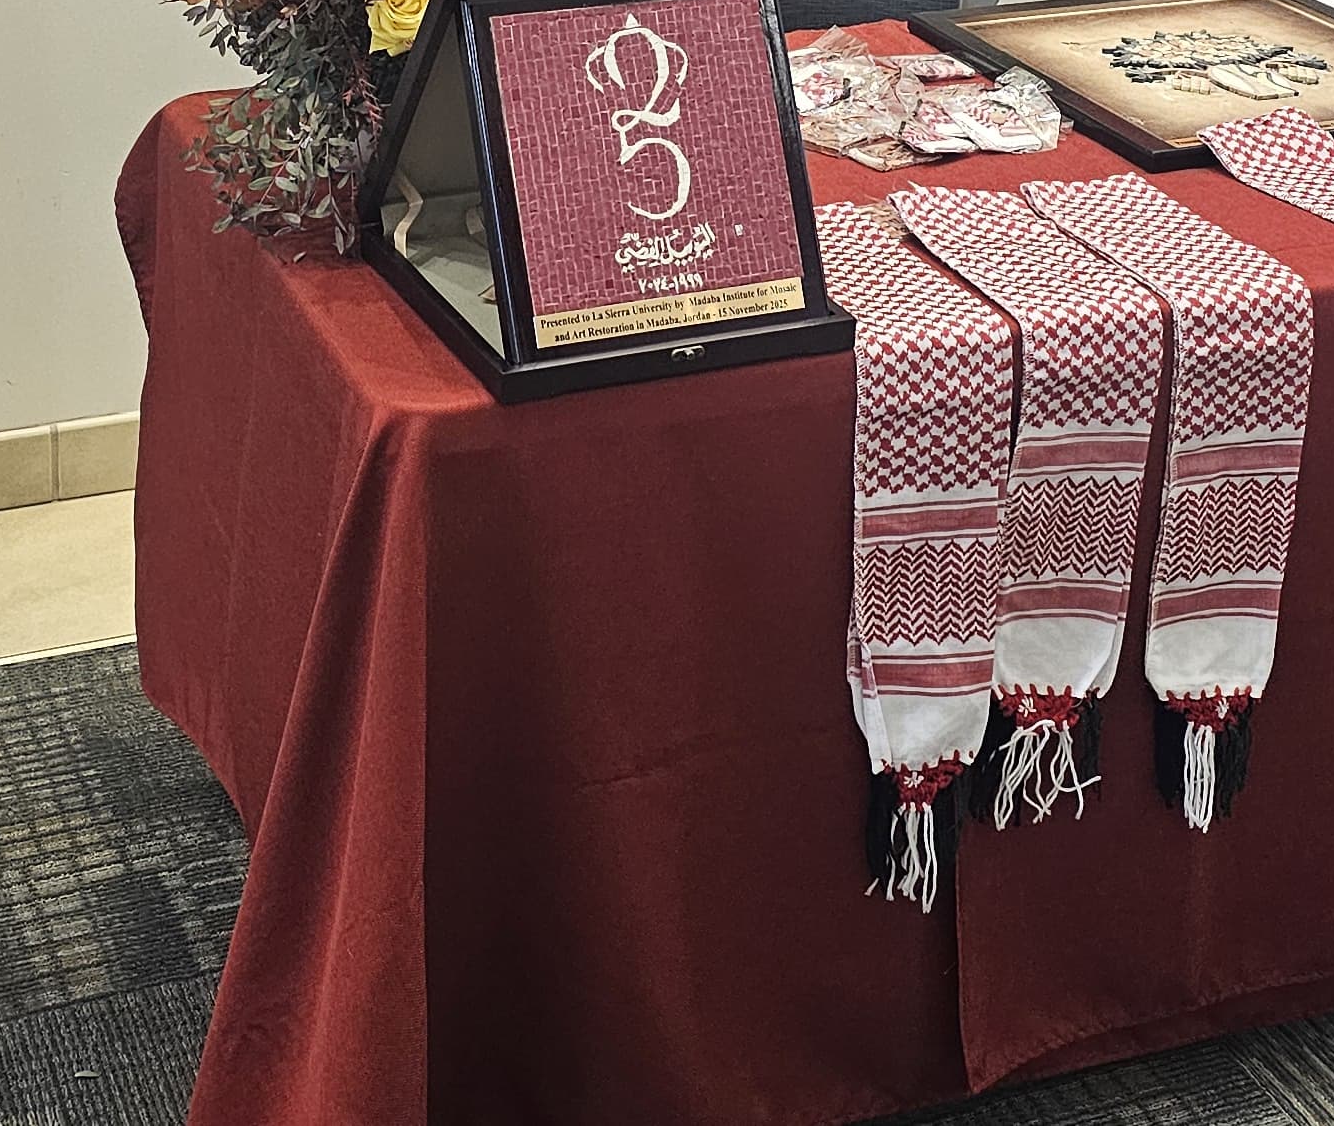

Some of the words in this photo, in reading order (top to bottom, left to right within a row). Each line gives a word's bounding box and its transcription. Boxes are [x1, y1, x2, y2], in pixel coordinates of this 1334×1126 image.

[540, 316, 581, 329] Presented
[582, 314, 591, 322] to
[592, 312, 604, 321] La
[605, 308, 631, 320] Sierra
[632, 301, 673, 316] University
[674, 300, 685, 311] by
[689, 295, 721, 307] Madaba
[722, 290, 755, 302] Institute
[757, 286, 768, 296] for
[770, 283, 797, 295] Mosaic
[555, 332, 571, 342] and
[572, 329, 587, 340] Art
[587, 322, 635, 338] Restoration
[636, 320, 645, 330] in
[646, 315, 682, 329] Madaba,
[683, 311, 711, 323] Jordan
[718, 307, 727, 318] 15
[729, 302, 768, 317] November
[770, 298, 788, 311] 2025
